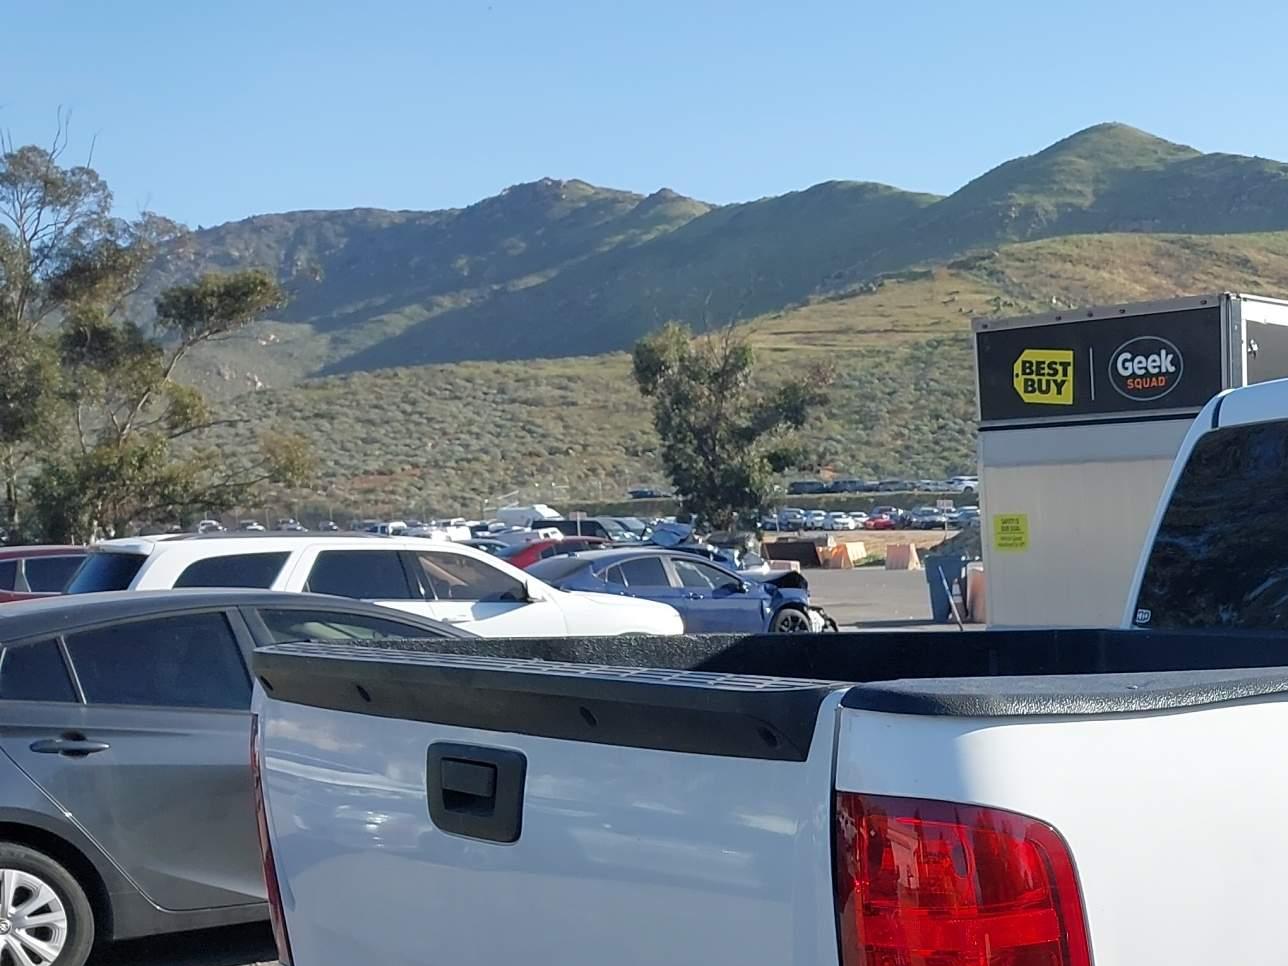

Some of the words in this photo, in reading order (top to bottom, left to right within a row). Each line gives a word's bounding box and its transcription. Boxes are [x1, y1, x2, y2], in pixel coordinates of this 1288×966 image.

[1021, 360, 1071, 377] BEST
[1116, 349, 1176, 376] Geek
[1023, 378, 1066, 395] BUY
[1126, 376, 1166, 389] SQUAD
